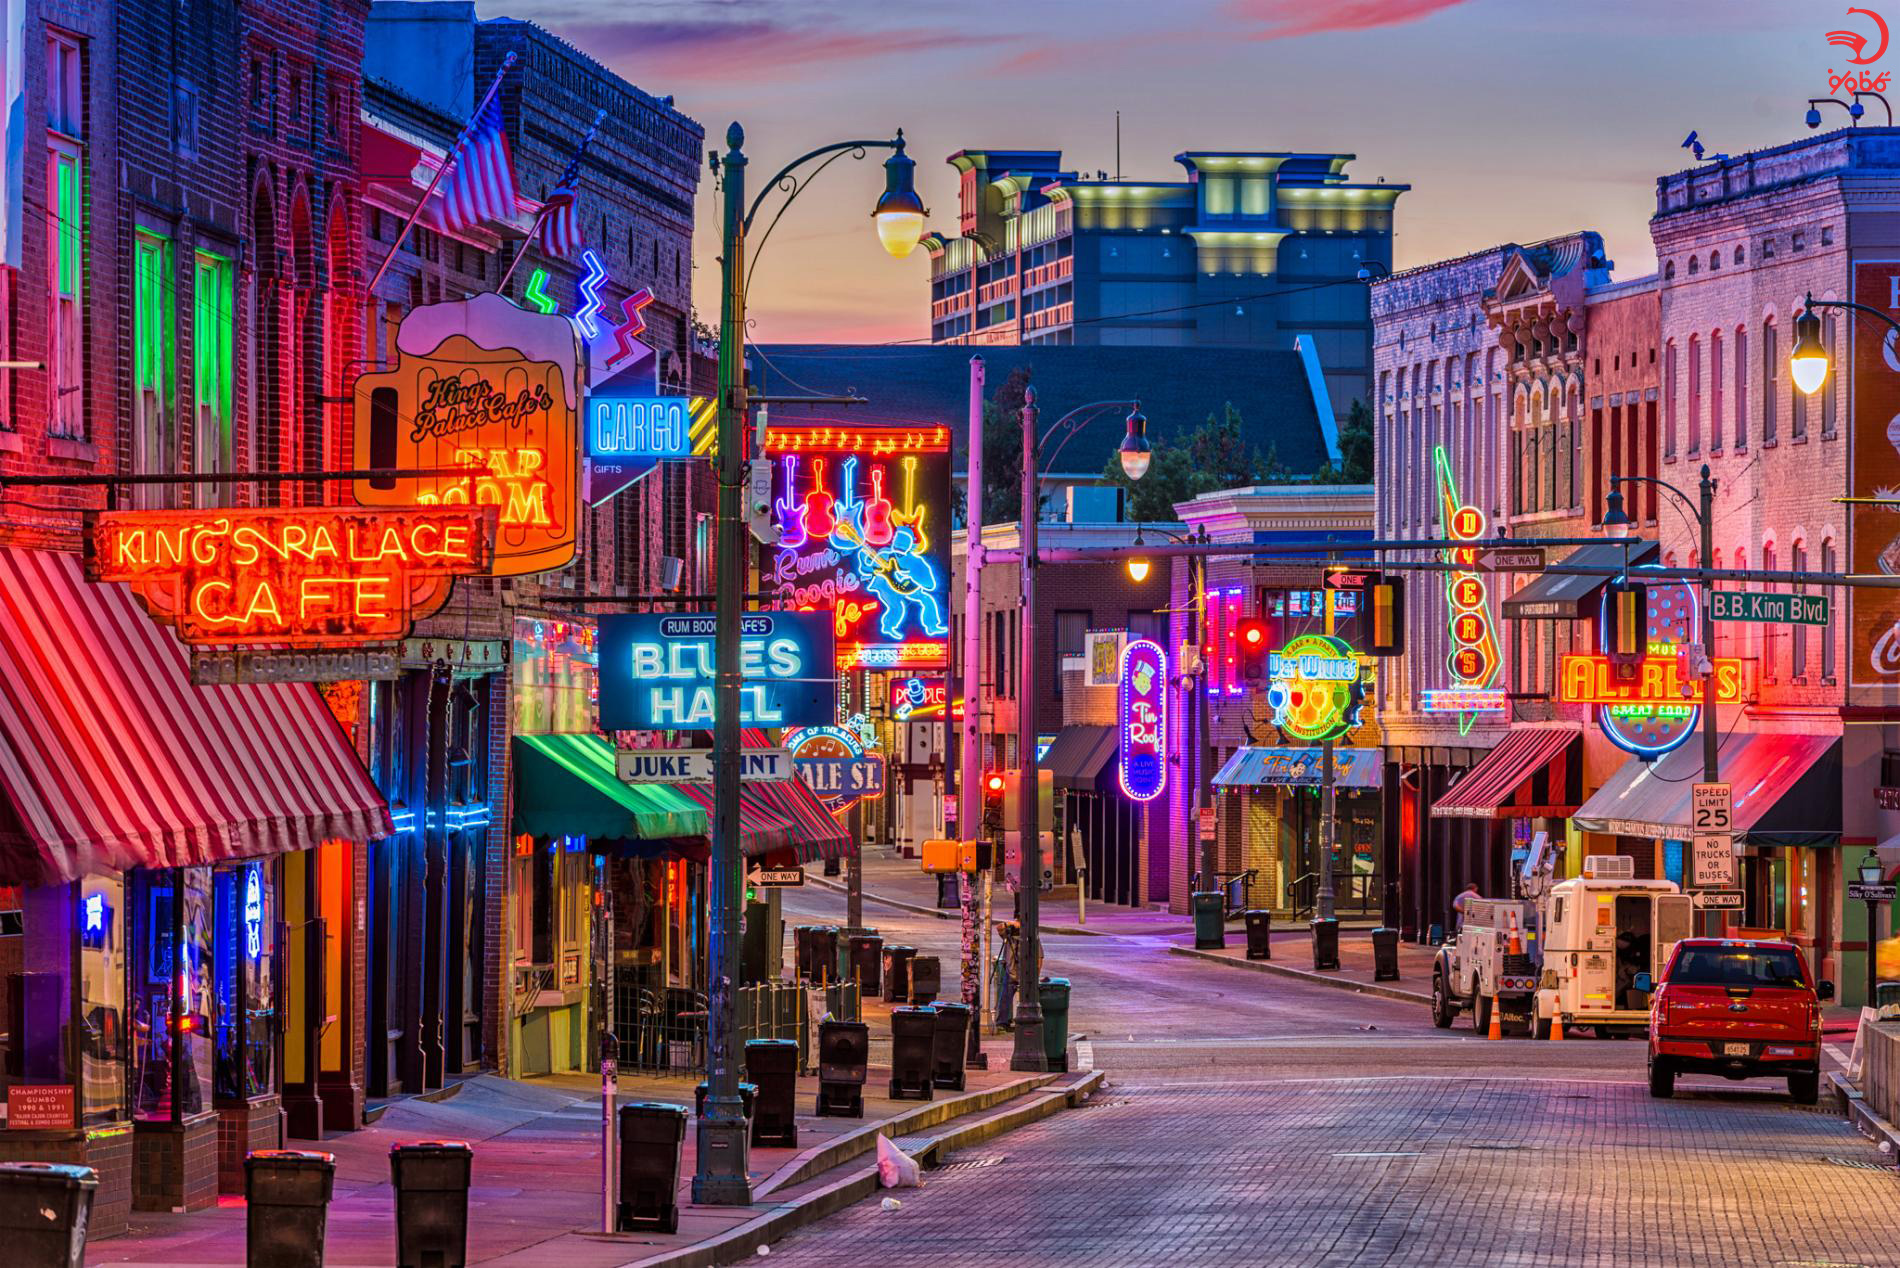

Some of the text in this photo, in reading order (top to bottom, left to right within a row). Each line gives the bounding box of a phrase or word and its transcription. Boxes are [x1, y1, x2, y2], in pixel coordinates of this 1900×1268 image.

[422, 376, 492, 412] Kings
[410, 384, 554, 443] Palace Cafe's
[597, 403, 681, 451] CARGO
[454, 448, 545, 485] TAP
[593, 465, 622, 474] GIFTS
[416, 482, 551, 524] OM
[1495, 555, 1537, 565] ONE WAY
[771, 567, 860, 611] Boogie
[196, 577, 390, 625] CAFE
[1714, 595, 1827, 622] B.B. King Blvd.
[667, 620, 690, 633] RUM
[740, 619, 767, 632] AFE'S
[632, 638, 802, 679] BLUES
[1649, 644, 1677, 656] MUS
[251, 652, 395, 676] CONDITIONED
[1567, 658, 1737, 699] ALRES
[650, 685, 783, 724] HAL
[1132, 701, 1158, 724] Tin
[1612, 704, 1691, 716] GREAT FOOD
[822, 726, 839, 735] THE
[1128, 723, 1163, 753] Roof
[629, 754, 780, 776] JUKE INT
[800, 762, 880, 790] ALE ST.
[1695, 788, 1728, 797] SPEED
[1699, 799, 1725, 807] LIMIT
[1696, 809, 1729, 827] 25
[1696, 850, 1731, 859] TRUCKS
[1706, 841, 1719, 849] NO
[1707, 861, 1720, 869] OR
[761, 872, 798, 881] ONE WAY
[1699, 871, 1729, 880] BUSES
[1703, 896, 1738, 904] ONE WAY
[10, 1088, 72, 1096] CHAMPIONSHIP
